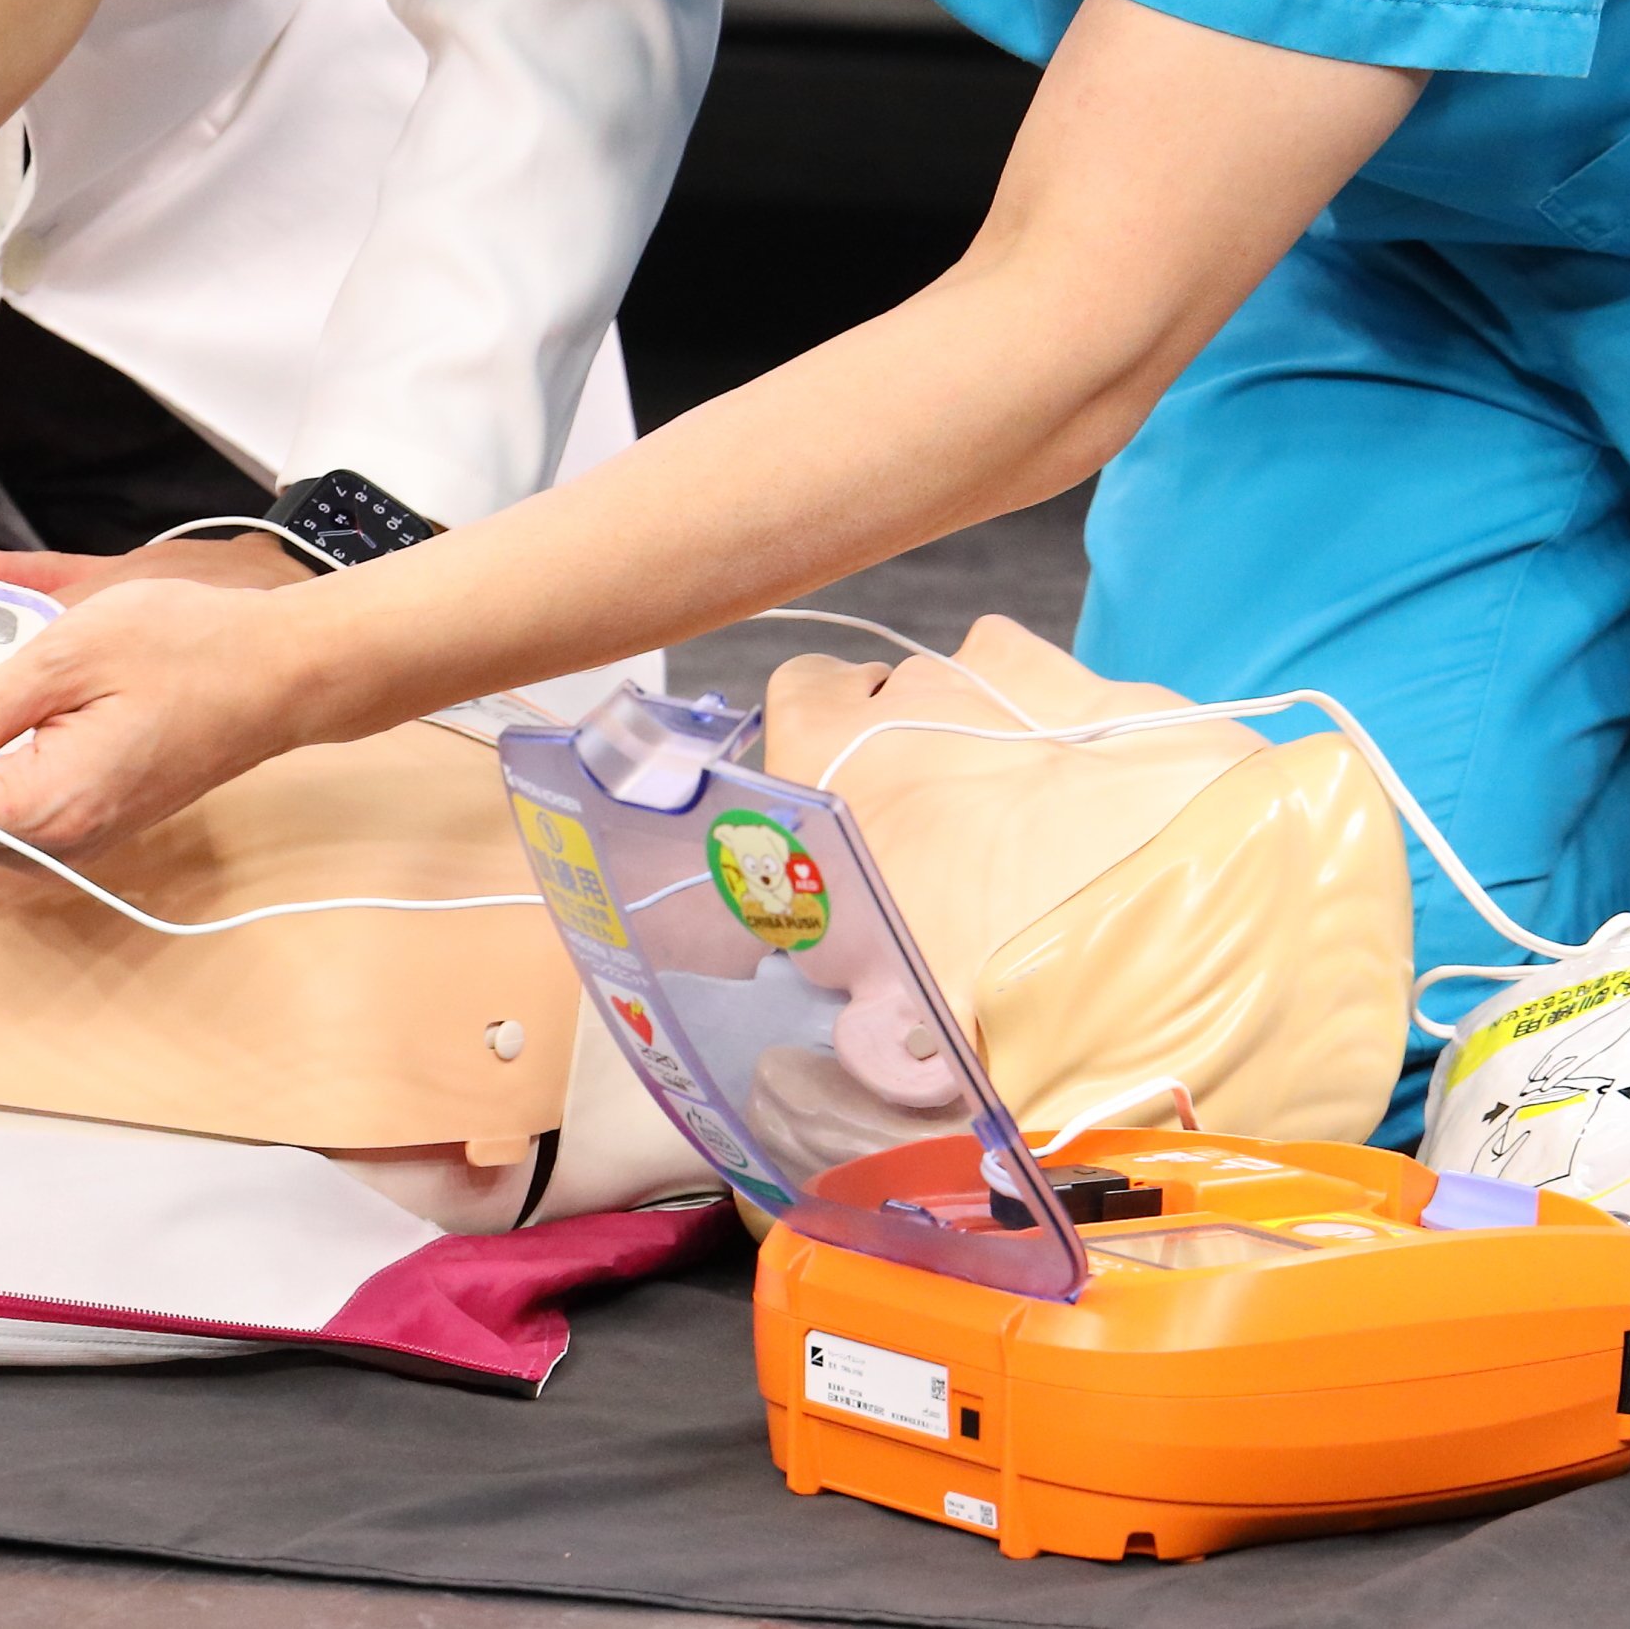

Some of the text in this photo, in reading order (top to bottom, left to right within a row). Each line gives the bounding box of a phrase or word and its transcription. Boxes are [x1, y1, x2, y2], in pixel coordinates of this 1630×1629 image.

[335, 484, 347, 497] 7
[355, 491, 368, 503] 8
[317, 502, 331, 514] 6
[373, 503, 385, 515] 9
[303, 519, 317, 531] 5
[386, 515, 402, 531] 10
[314, 537, 327, 549] 4
[399, 533, 414, 546] 11
[332, 548, 346, 560] 3
[1513, 987, 1609, 1039] 訓練用
